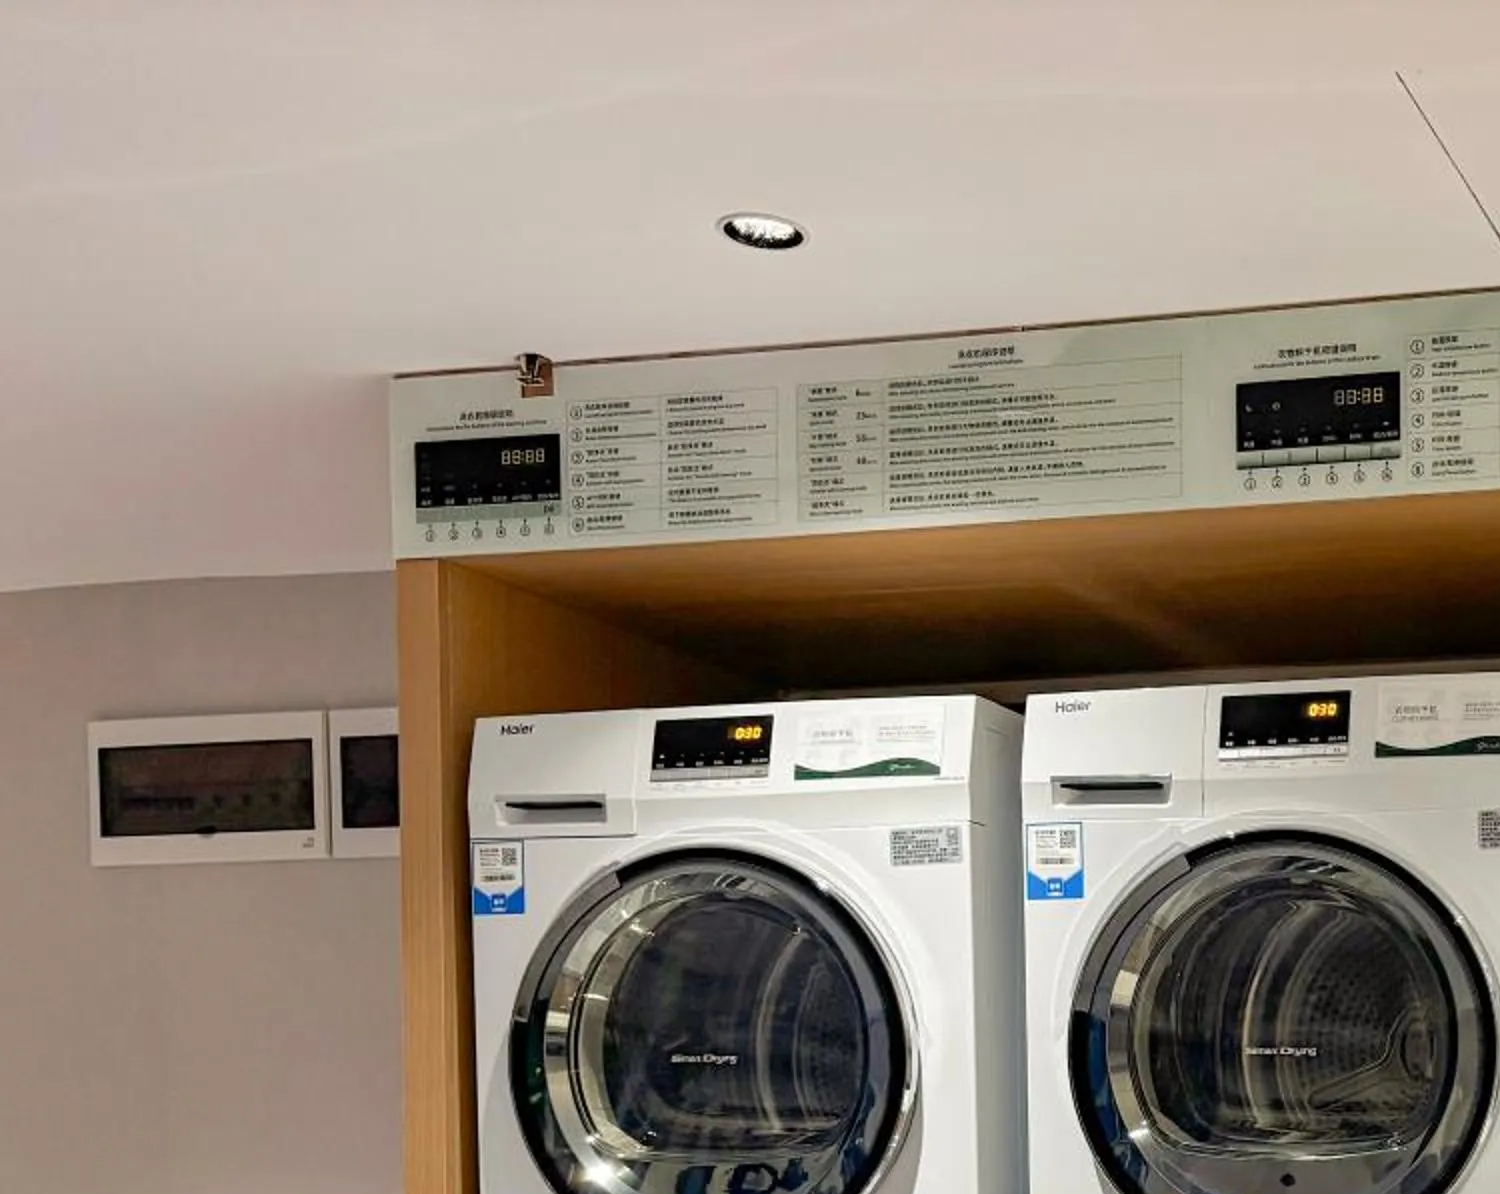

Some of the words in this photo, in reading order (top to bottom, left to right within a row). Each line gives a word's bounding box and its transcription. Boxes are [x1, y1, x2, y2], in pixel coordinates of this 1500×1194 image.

[1055, 701, 1091, 713] Haier
[500, 723, 535, 735] Haier
[1280, 1047, 1317, 1057] Drying
